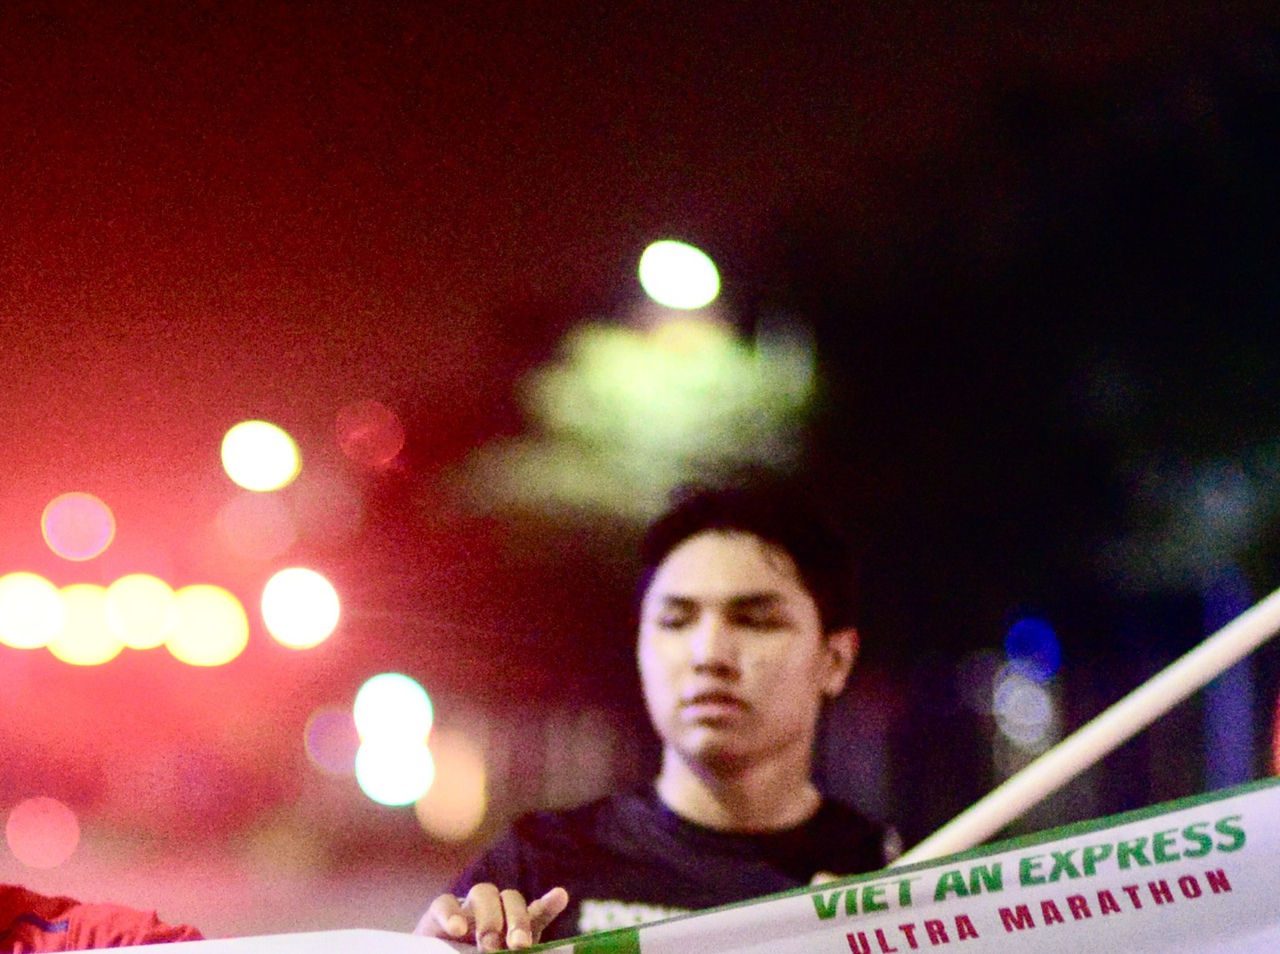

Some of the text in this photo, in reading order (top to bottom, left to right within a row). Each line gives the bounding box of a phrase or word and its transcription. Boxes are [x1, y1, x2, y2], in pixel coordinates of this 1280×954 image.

[811, 814, 1247, 921] VIET AN EXPRESS
[998, 868, 1233, 933] MARATHON
